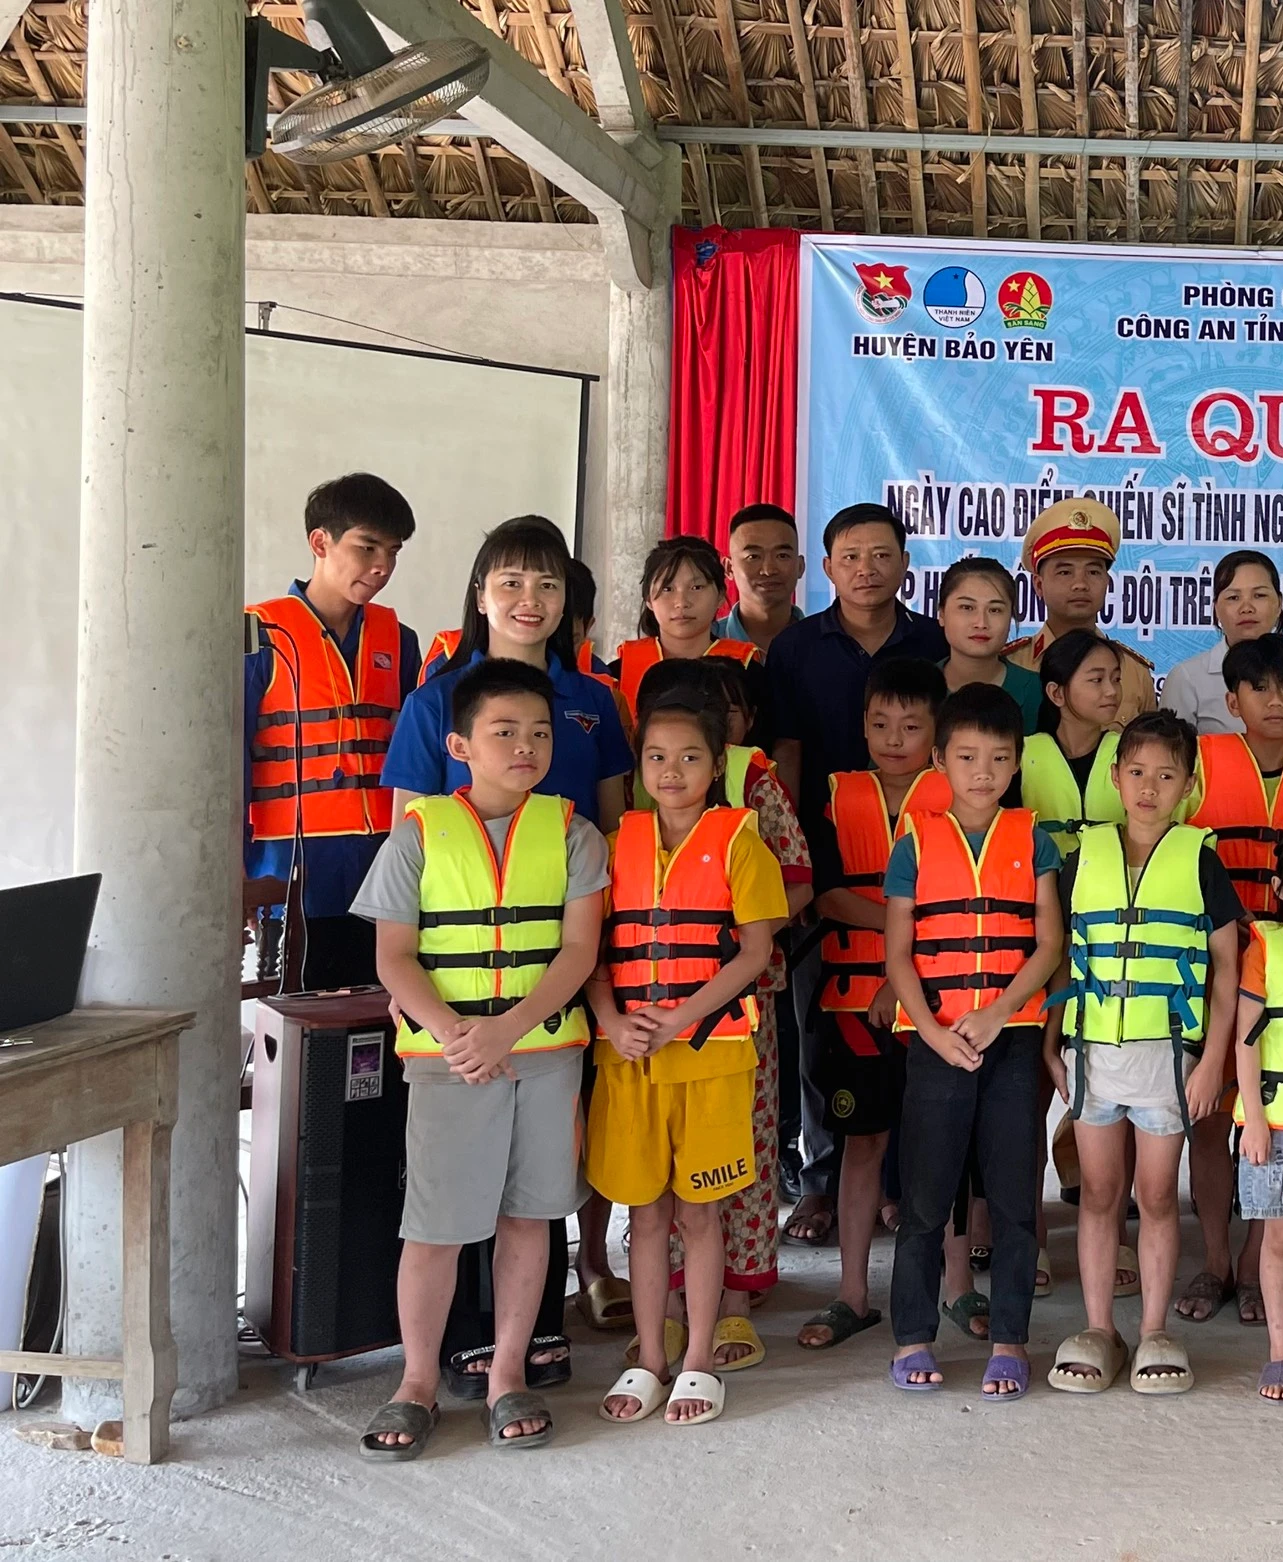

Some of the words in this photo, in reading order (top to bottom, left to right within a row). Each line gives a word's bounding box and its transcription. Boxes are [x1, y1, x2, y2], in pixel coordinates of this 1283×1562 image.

[1184, 281, 1273, 308] PHÒNG
[1117, 313, 1190, 339] CÔNG
[1199, 319, 1235, 340] AN
[853, 332, 936, 361] HUYỆN
[945, 331, 995, 360] BẢO
[1004, 337, 1053, 361] YÊN
[1032, 389, 1161, 454] RA
[888, 475, 951, 535] NGÀY
[958, 486, 1005, 537] CAO
[1161, 482, 1184, 541] SĨ
[1192, 482, 1245, 542] TÌNH
[1122, 565, 1162, 636] ĐỘI
[1170, 566, 1213, 626] TRÊ
[690, 1158, 748, 1190] SMILE
